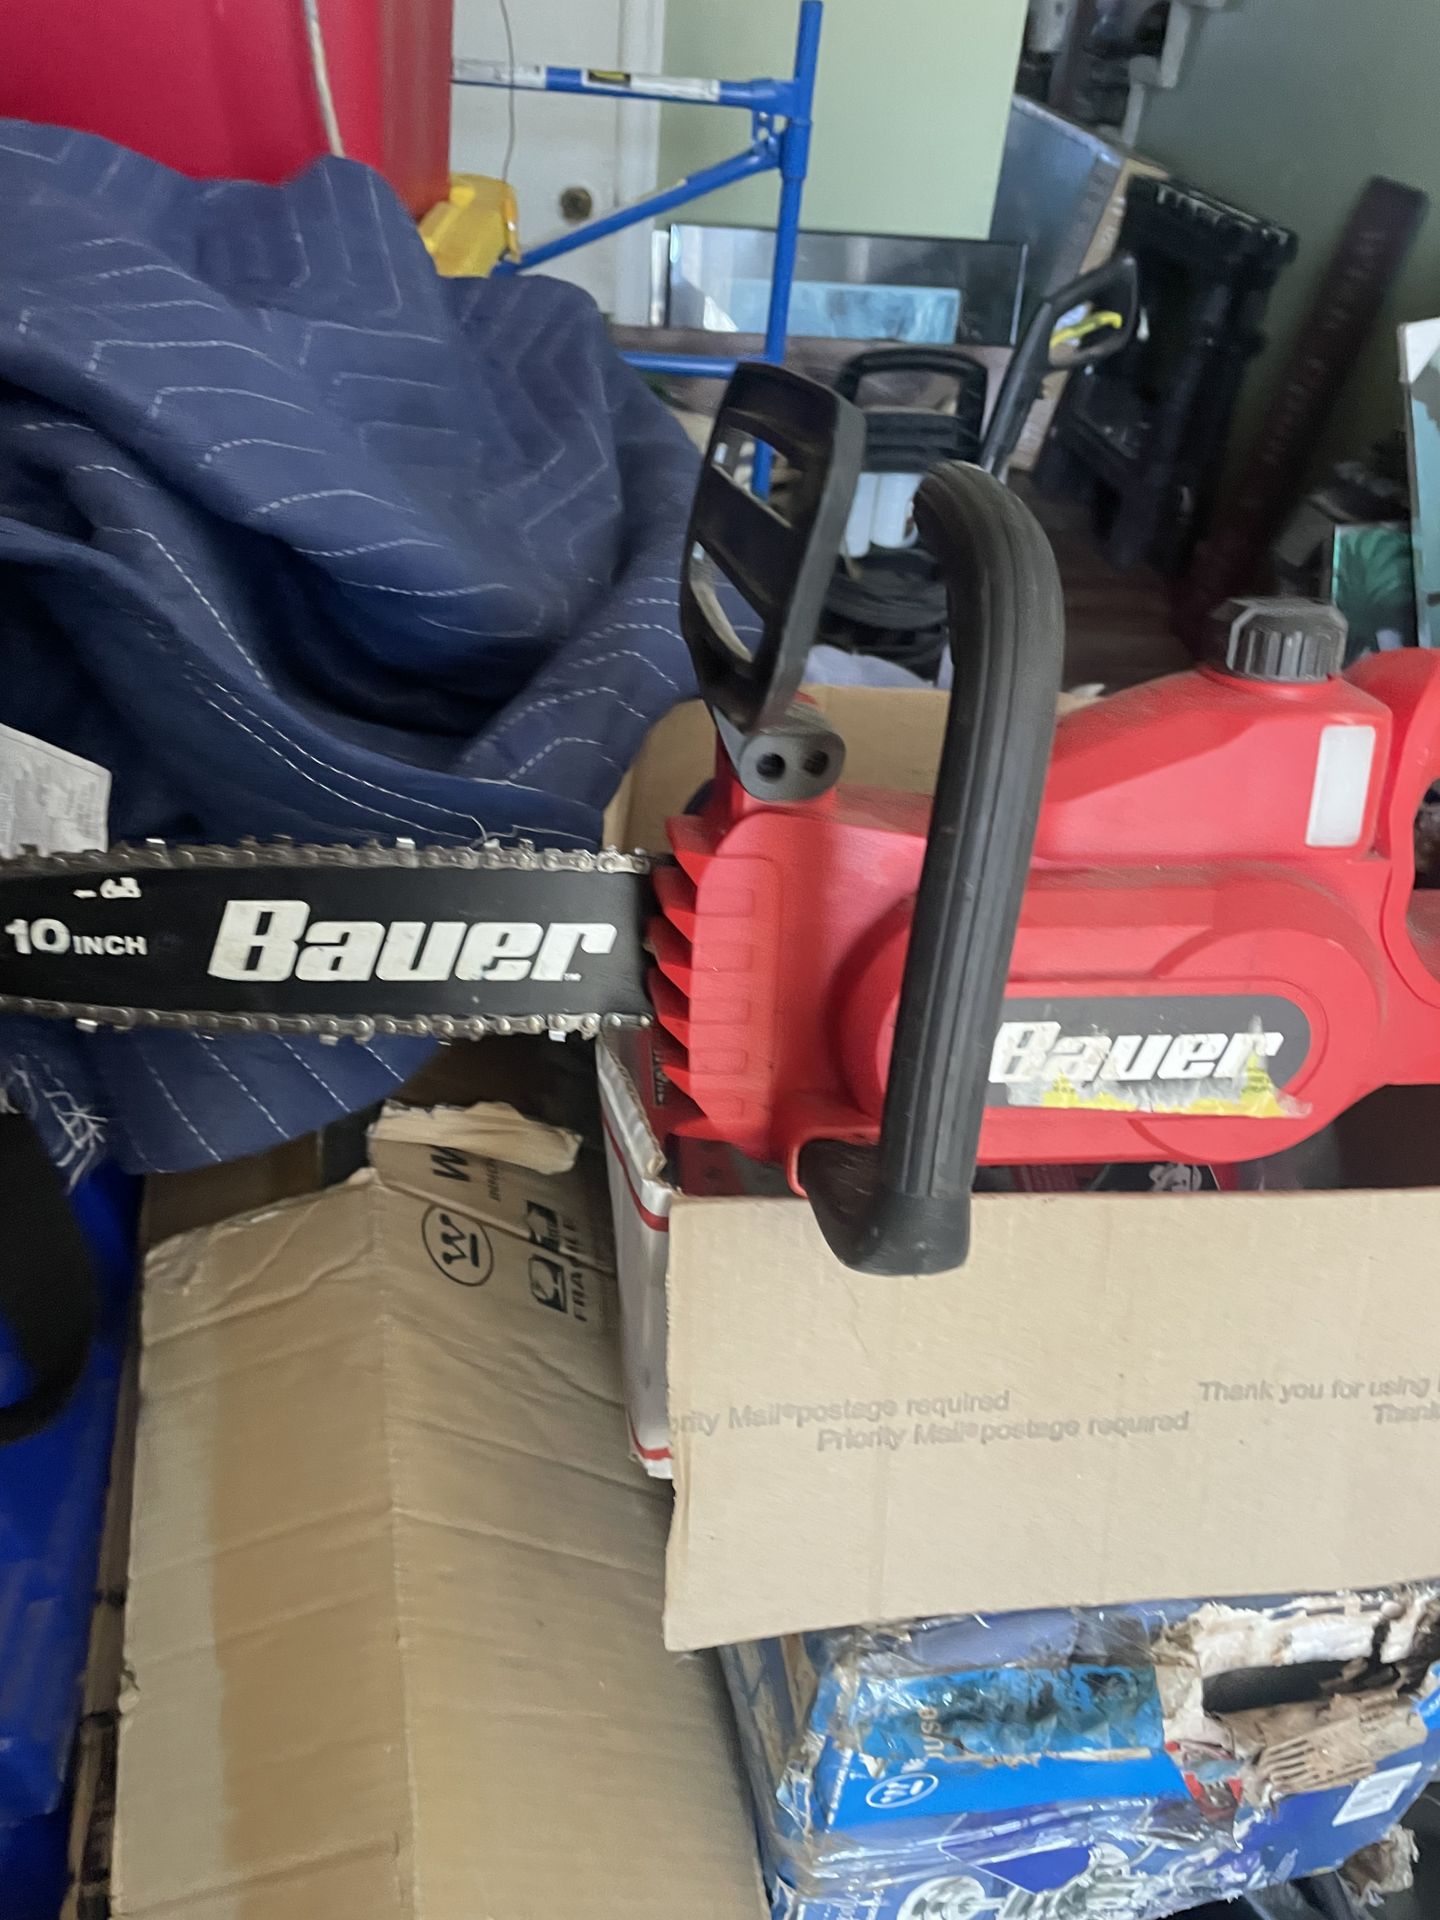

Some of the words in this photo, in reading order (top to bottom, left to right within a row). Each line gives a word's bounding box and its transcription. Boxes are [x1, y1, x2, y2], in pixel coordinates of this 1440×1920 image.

[72, 936, 148, 955] INCH
[207, 900, 618, 981] Bauer
[988, 1021, 1284, 1083] Bauer
[797, 1399, 897, 1429] postage
[905, 1389, 1010, 1419] required
[1199, 1379, 1274, 1402] Thank
[1279, 1380, 1324, 1404] you
[1331, 1378, 1365, 1400] for
[1367, 1375, 1431, 1399] using
[816, 1426, 906, 1452] Priority
[980, 1417, 1080, 1446] postage
[1087, 1410, 1189, 1437] required
